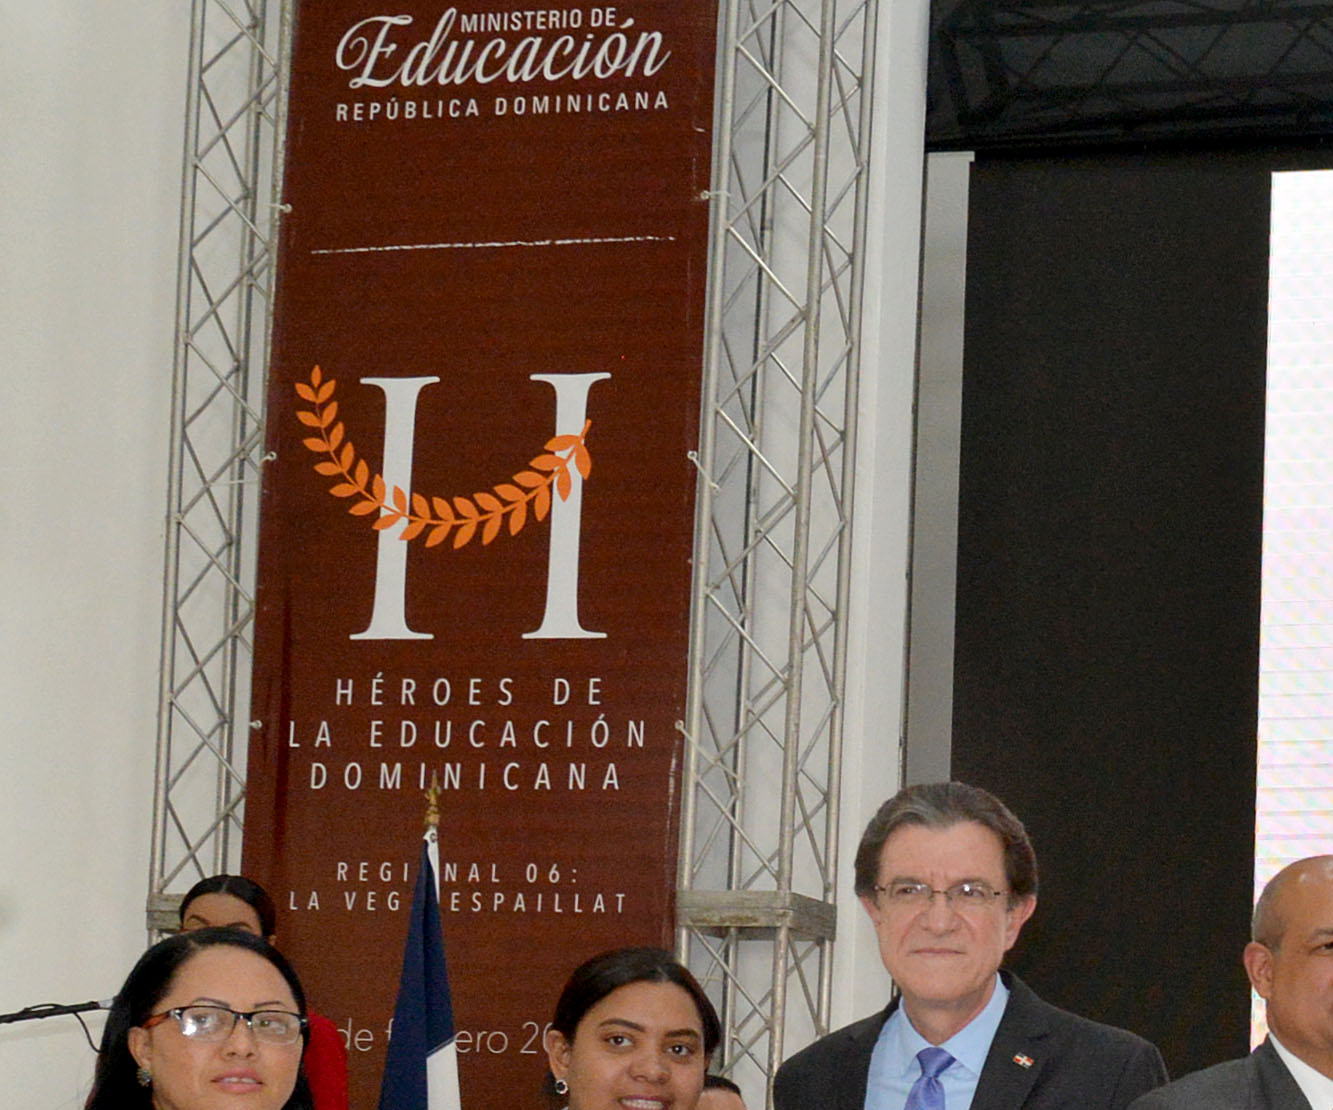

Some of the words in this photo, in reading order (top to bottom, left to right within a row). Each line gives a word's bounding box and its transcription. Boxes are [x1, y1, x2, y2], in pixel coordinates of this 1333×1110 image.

[461, 9, 582, 33] MINISTERIO
[590, 8, 616, 28] DE
[336, 7, 671, 89] Educación
[336, 98, 479, 122] REPÚBLICA
[495, 91, 668, 116] DOMINICANA
[335, 672, 514, 706] HÉROES
[552, 677, 603, 705] DE
[288, 720, 333, 748] LA
[369, 713, 647, 748] EDUCACIÓN
[310, 762, 621, 791] DOMINICANA
[337, 862, 501, 883] REGINAL
[525, 863, 579, 884] 06:
[289, 891, 320, 911] LA
